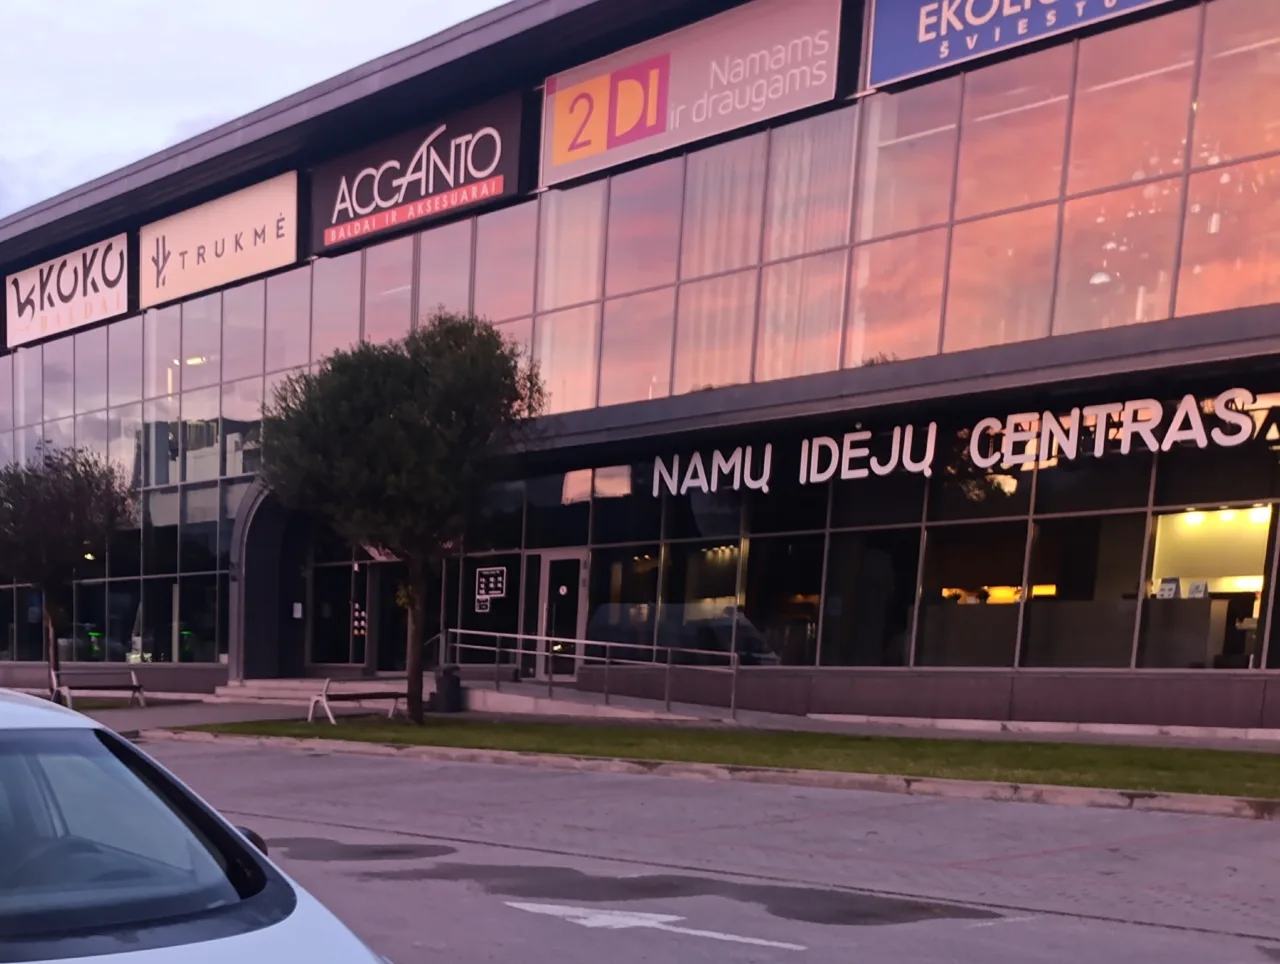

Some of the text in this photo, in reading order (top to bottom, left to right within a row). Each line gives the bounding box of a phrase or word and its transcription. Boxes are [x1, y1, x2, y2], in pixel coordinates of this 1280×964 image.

[918, 0, 1060, 43] EKOL
[710, 29, 830, 90] Namams
[670, 59, 827, 131] ir draugams
[332, 124, 502, 224] ACCANTO
[179, 212, 285, 270] TRUKMĖ
[330, 181, 497, 242] BALDAI IR AKSESUARAI
[39, 242, 125, 311] KOKO
[652, 387, 1255, 497] NAMŲ IDĖJŲ CENTRAS
